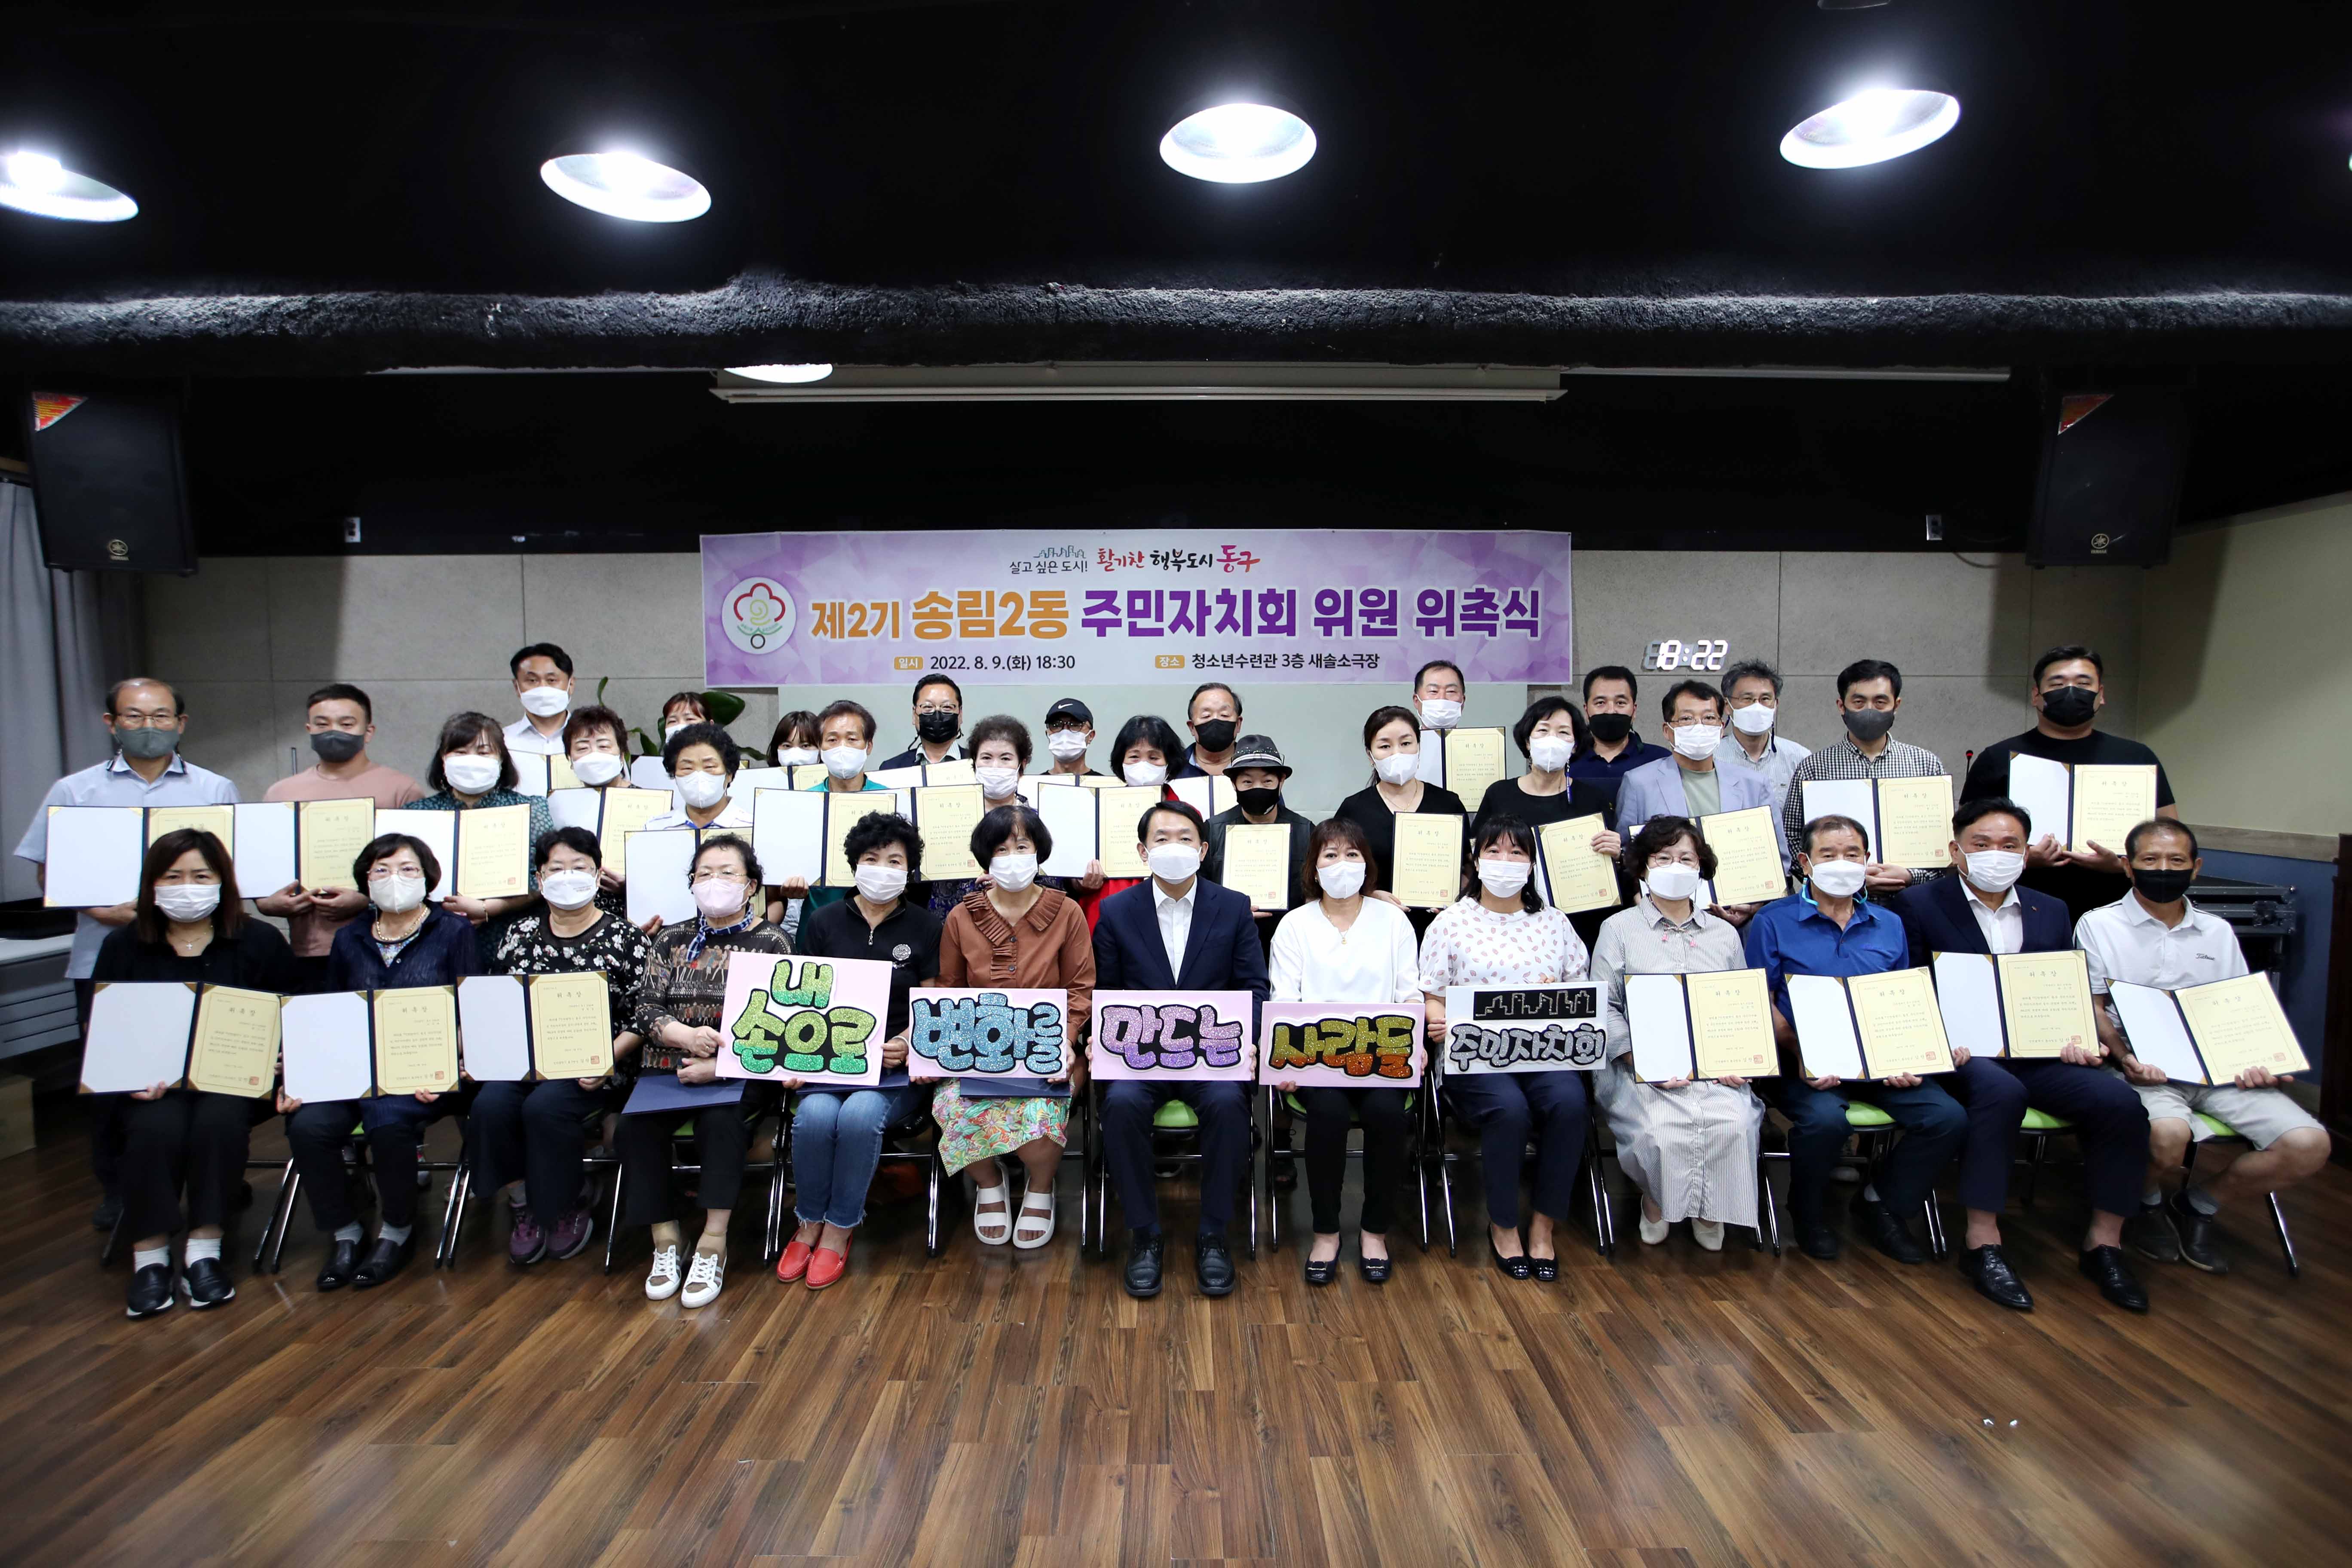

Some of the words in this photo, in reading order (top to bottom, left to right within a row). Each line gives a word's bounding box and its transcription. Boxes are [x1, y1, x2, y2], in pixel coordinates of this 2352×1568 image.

[1010, 560, 1033, 574] 살고
[1035, 560, 1058, 574] 싶은
[1061, 560, 1088, 573] 도시!
[1096, 548, 1145, 572] 활기찬
[1149, 548, 1213, 572] 행복도시
[1216, 545, 1261, 573] 동구
[811, 601, 900, 639] 제2기
[912, 590, 1069, 640] 송림2동
[1081, 588, 1296, 637] 주민자치회
[1314, 588, 1398, 637] 위원
[1416, 588, 1539, 637] 위촉식
[898, 657, 919, 668] 일시
[930, 656, 970, 670] 2022.
[974, 656, 988, 670] 8.
[992, 655, 1031, 671] 9.(화)
[1035, 655, 1075, 669] 18:30
[1159, 656, 1180, 667] 장소
[1192, 653, 1278, 669] 청소년수련관
[1281, 653, 1305, 669] 3층
[1308, 653, 1380, 669] 새솔소극장
[771, 959, 834, 1009] 내
[732, 988, 876, 1075] 손으로
[911, 992, 1063, 1073] 변화를
[1100, 1003, 1243, 1069] 만드는
[1269, 1016, 1416, 1079] 사람들
[1450, 1023, 1606, 1071] 주민자치회
